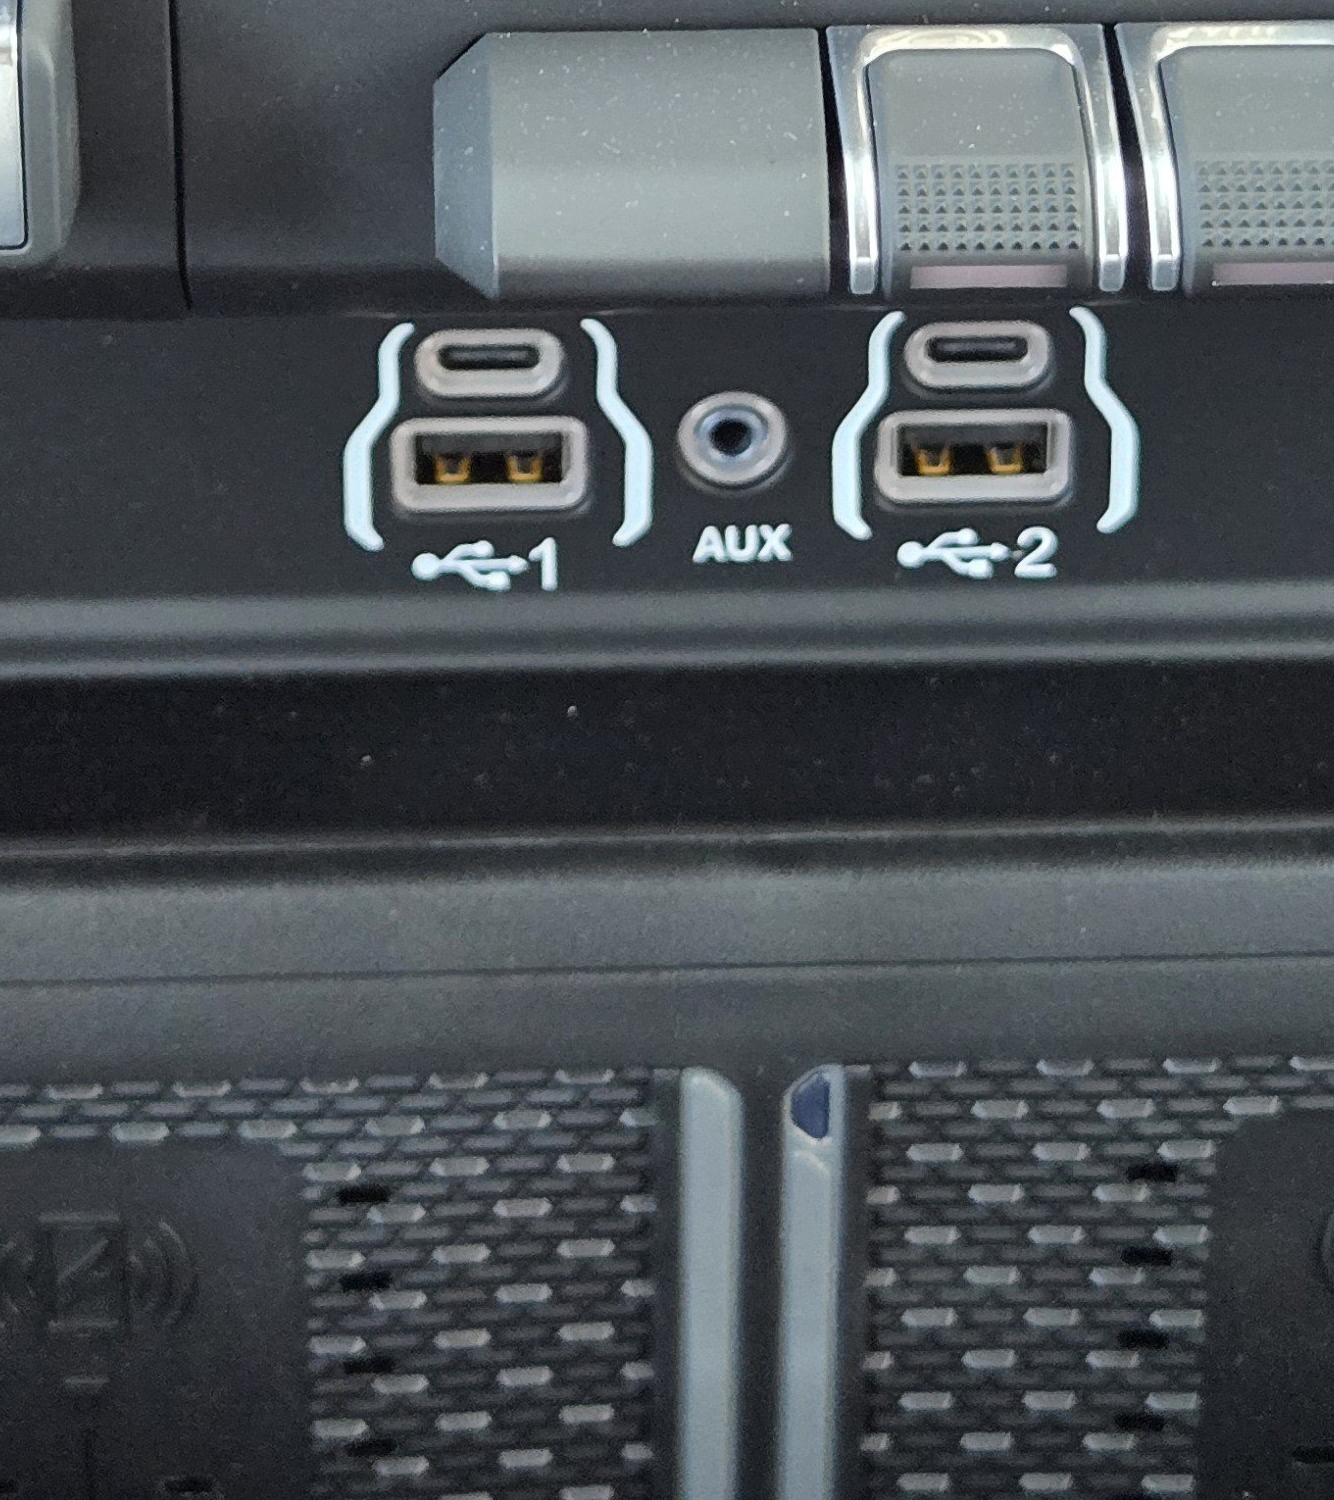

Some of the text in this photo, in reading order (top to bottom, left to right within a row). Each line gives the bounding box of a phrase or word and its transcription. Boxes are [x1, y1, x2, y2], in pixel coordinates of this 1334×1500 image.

[529, 537, 558, 591] 1
[692, 523, 792, 563] AUX
[1014, 526, 1058, 578] 2
